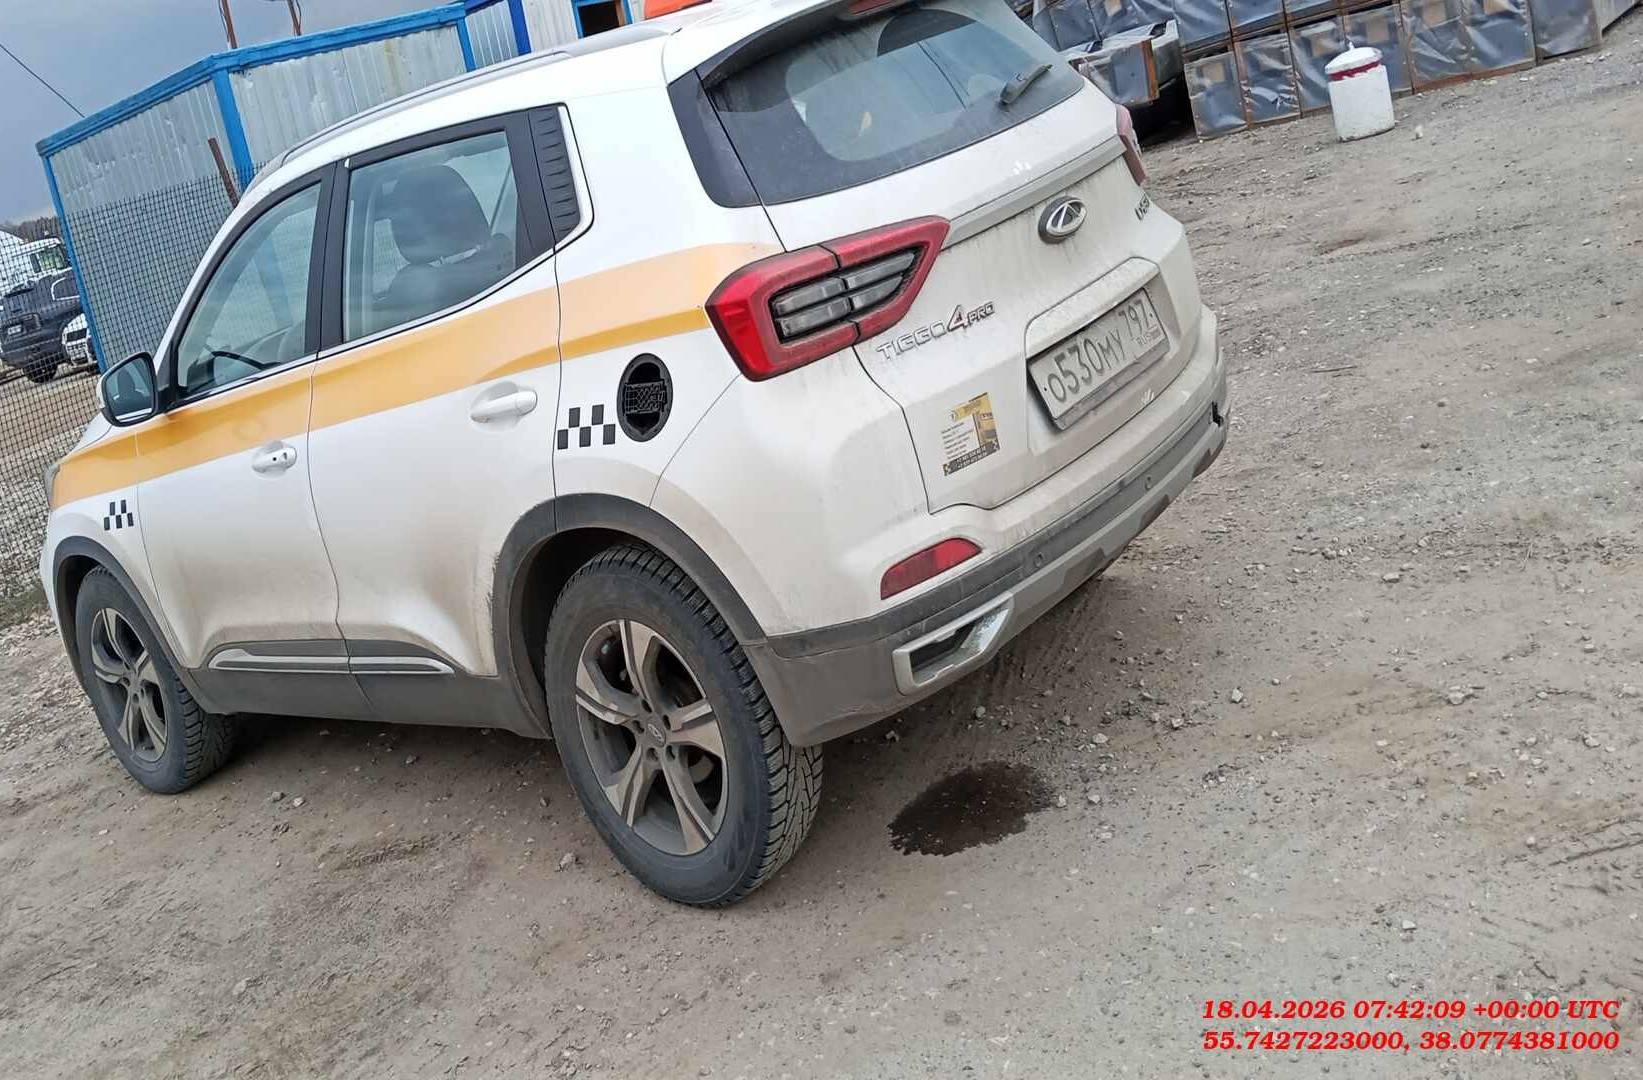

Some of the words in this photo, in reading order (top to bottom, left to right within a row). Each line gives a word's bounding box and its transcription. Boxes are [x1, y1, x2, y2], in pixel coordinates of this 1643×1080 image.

[876, 320, 947, 360] TIGGO
[947, 304, 970, 332] 4
[966, 301, 996, 326] PRO
[1118, 299, 1149, 338] 797
